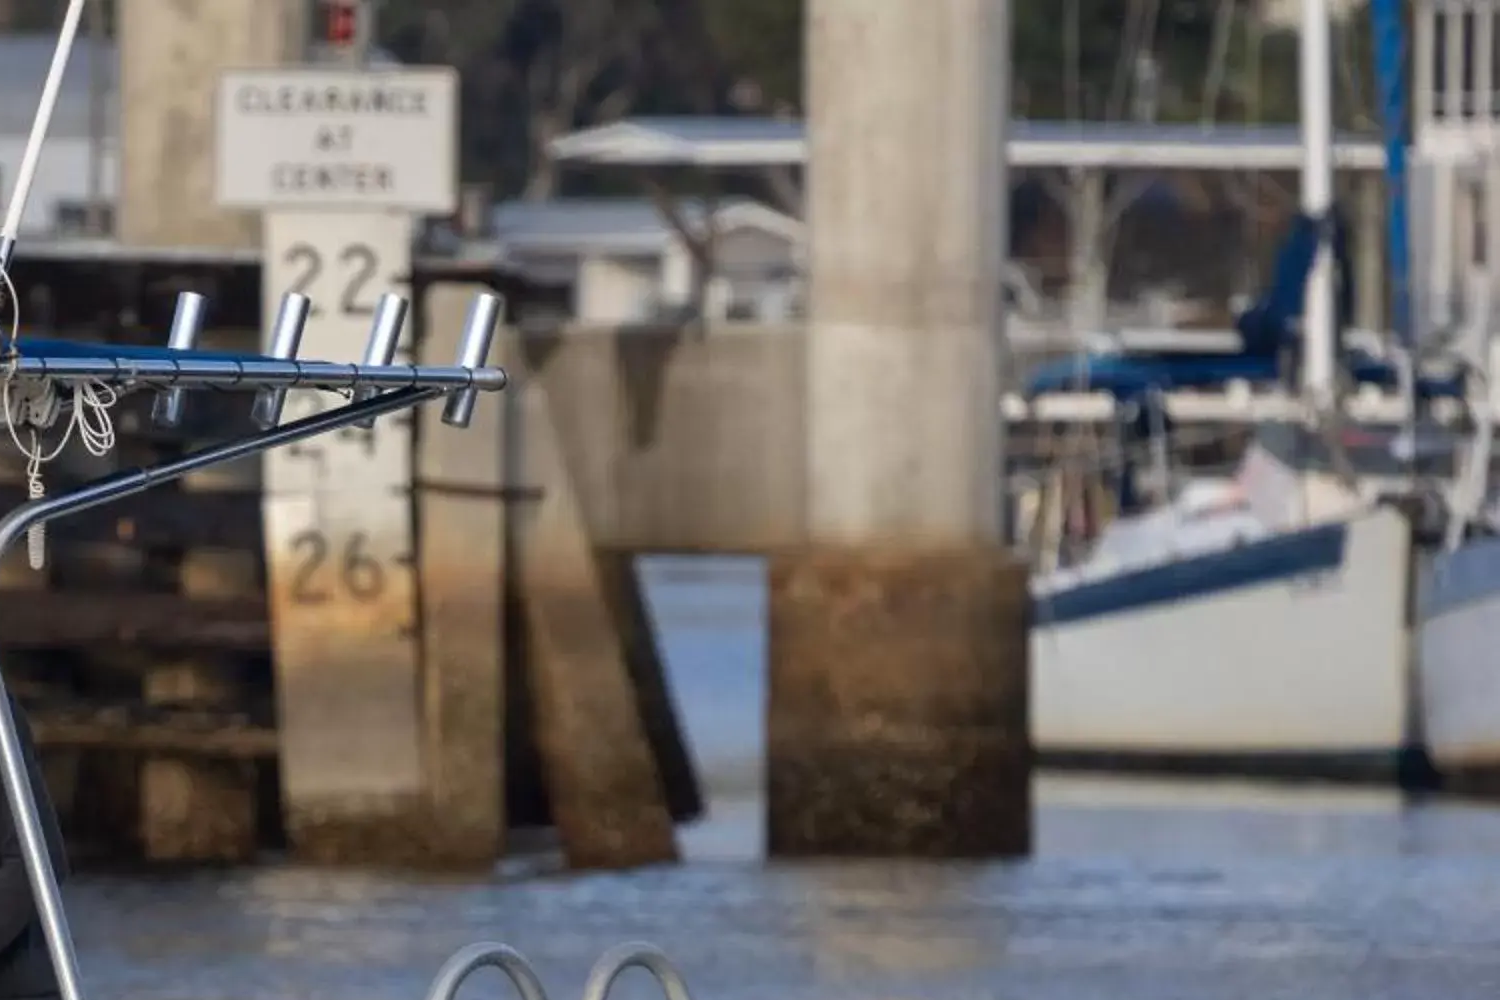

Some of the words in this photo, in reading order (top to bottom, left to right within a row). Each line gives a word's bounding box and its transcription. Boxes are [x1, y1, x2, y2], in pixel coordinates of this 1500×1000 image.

[235, 85, 429, 115] CLEARANCE
[314, 125, 353, 151] AT
[270, 162, 395, 193] CENTER
[284, 242, 380, 315] 22
[290, 530, 384, 604] 26
